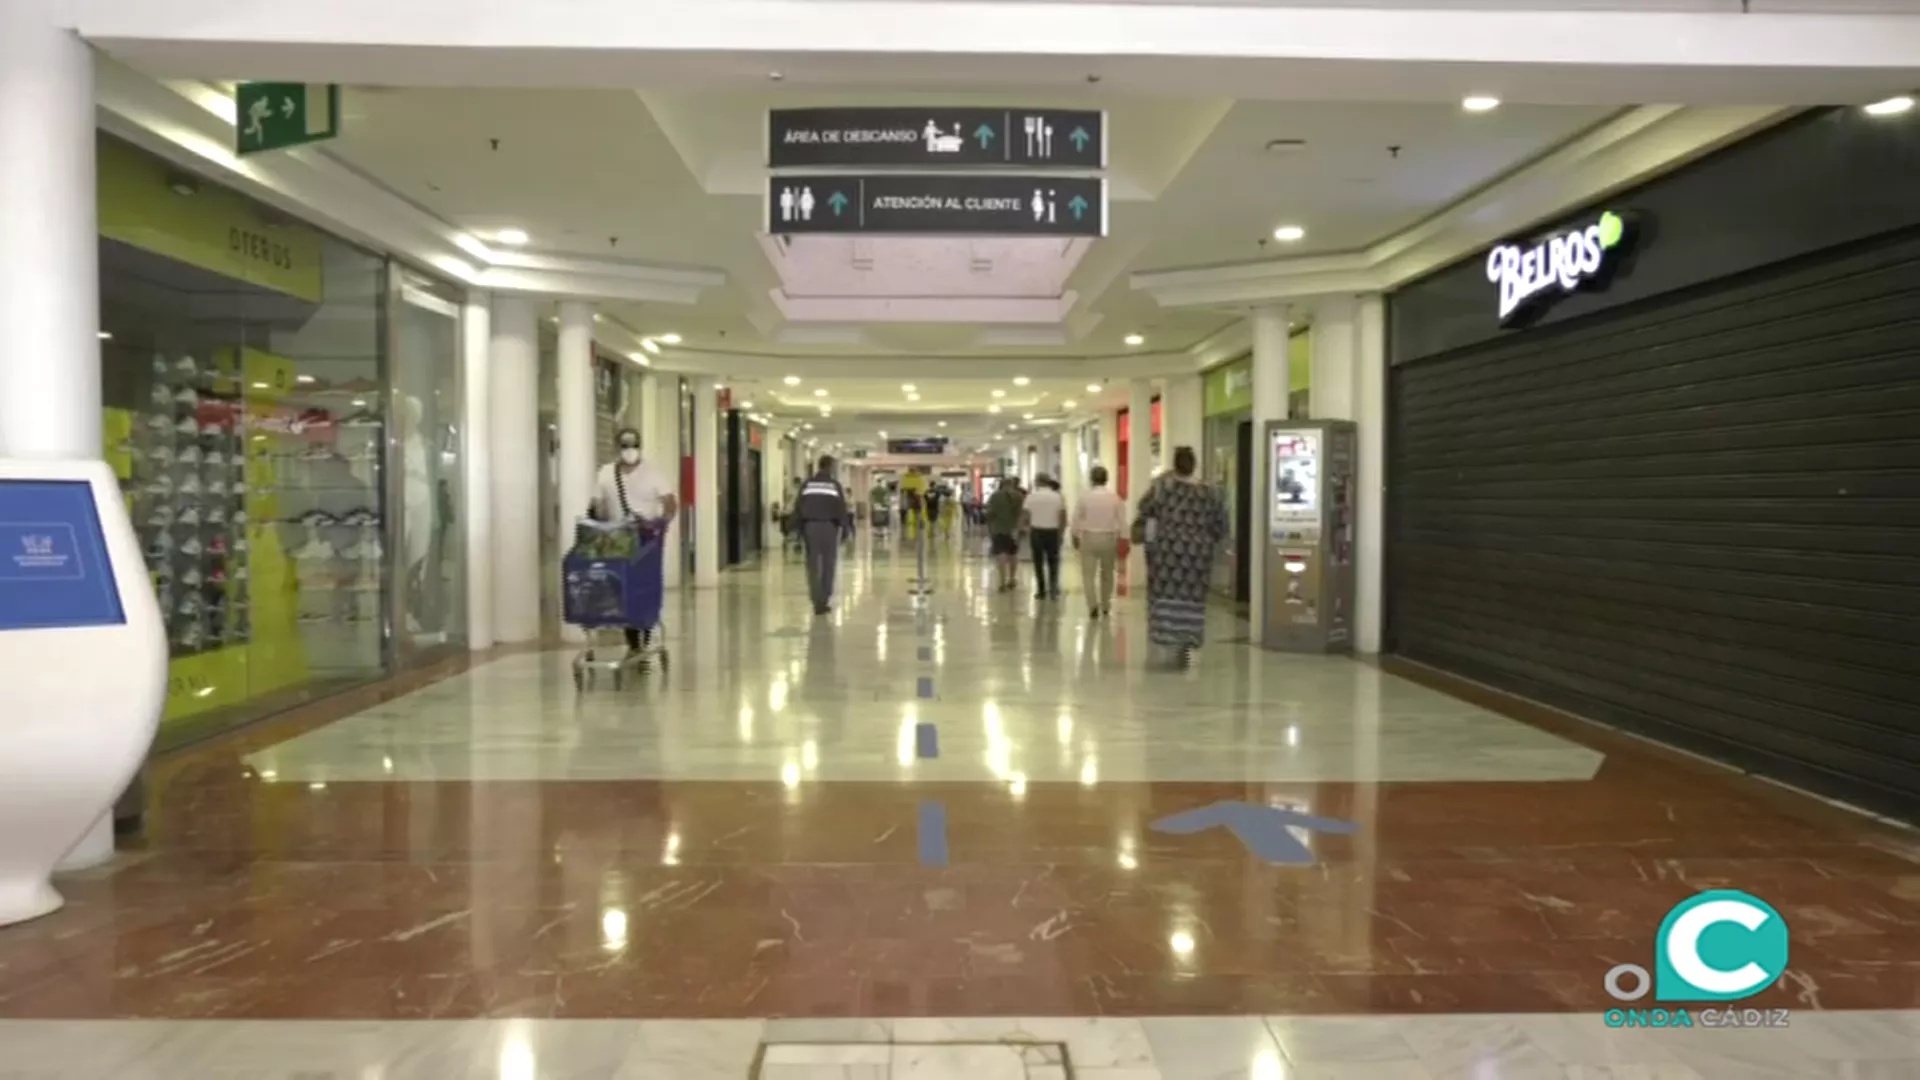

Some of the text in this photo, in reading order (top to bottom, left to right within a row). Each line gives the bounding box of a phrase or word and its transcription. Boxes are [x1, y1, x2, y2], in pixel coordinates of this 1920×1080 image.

[784, 127, 918, 143] ÁREA DE DESCANSO
[872, 195, 1021, 211] ATENCIÓN AL CLIENTE
[1486, 225, 1601, 318] BELROS
